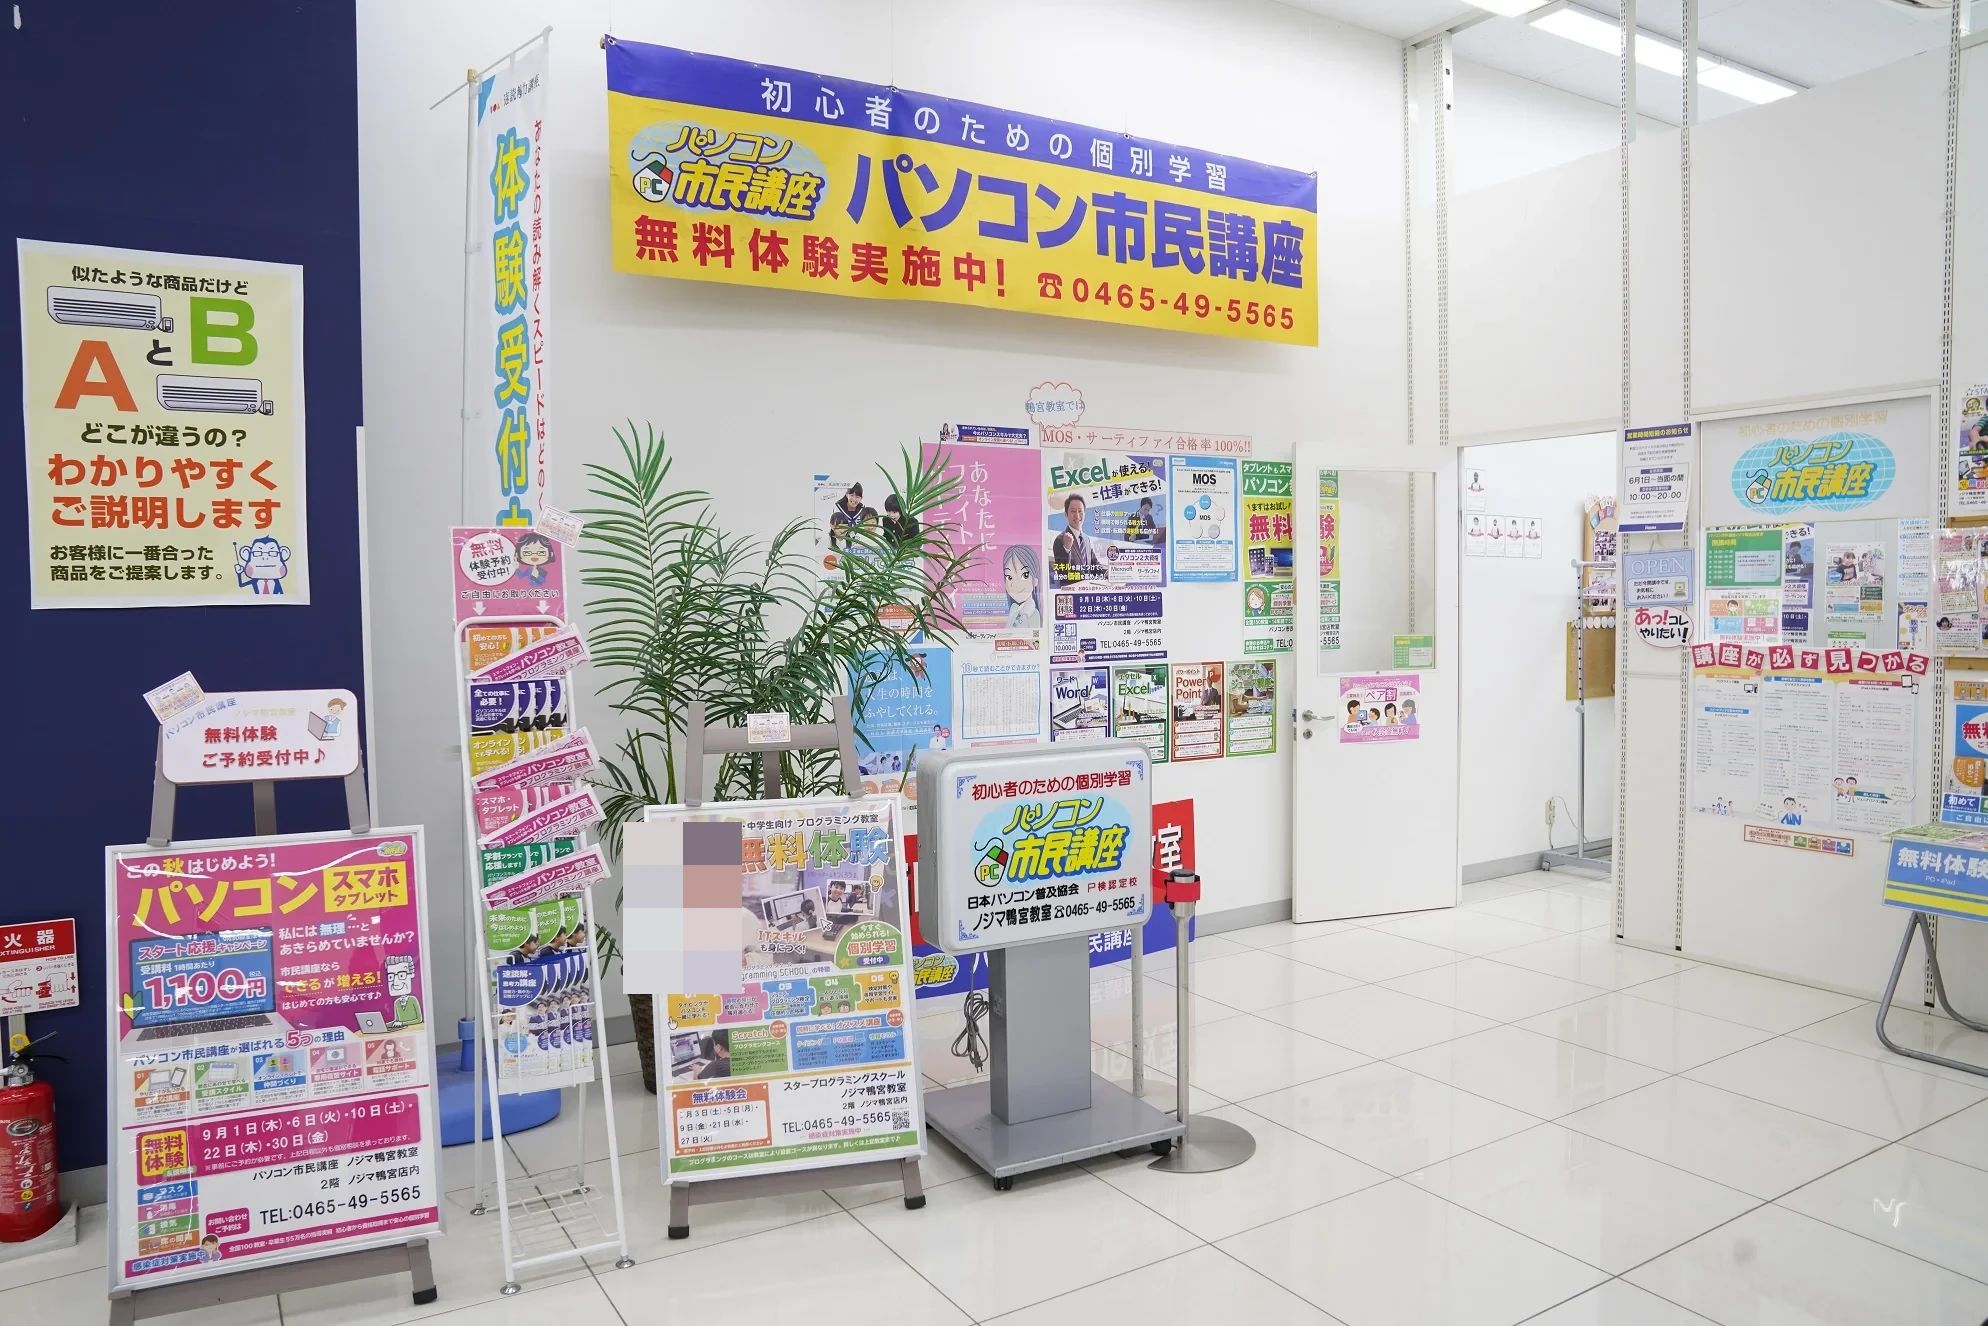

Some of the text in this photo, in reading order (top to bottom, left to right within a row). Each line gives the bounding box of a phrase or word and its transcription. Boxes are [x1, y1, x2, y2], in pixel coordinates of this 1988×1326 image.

[760, 77, 1229, 192] 初心者のための個別学習
[665, 125, 794, 165] パソコン
[639, 177, 664, 196] PC
[673, 157, 824, 220] 市民講座
[846, 152, 1304, 290] パソコン市民講座
[634, 214, 1006, 298] 無料体験実施中!
[71, 265, 249, 296] 似たような商品だけど
[1072, 276, 1295, 331] 0465-49-5565
[54, 295, 259, 413] A と B
[1025, 400, 1085, 413] 鴨宮教室では
[80, 422, 248, 448] どこが違うの?
[1767, 439, 1854, 468] パソコン
[47, 453, 279, 492] わかりやすく
[1193, 473, 1217, 485] MOS
[1770, 461, 1878, 503] 市民講座
[1749, 486, 1765, 499] PC
[51, 494, 282, 530] ご説明します
[969, 461, 998, 552] あなたに
[49, 544, 214, 562] お客様に一番合った
[50, 564, 223, 582] 商品をご提案します。
[469, 557, 512, 572] 体験予約
[1631, 557, 1688, 576] OPEN
[461, 589, 560, 600] ご自由にお取りください
[1639, 625, 1688, 643] やりたい!
[1694, 643, 1928, 673] 講座が必ず見つかる
[1118, 682, 1151, 696] Excel
[1176, 676, 1207, 688] Power
[1056, 685, 1089, 700] Word
[1176, 688, 1202, 699] Point
[1365, 687, 1397, 702] ペア割
[864, 704, 939, 719] ふやしてくれる。
[203, 725, 279, 745] 無料体験
[473, 738, 512, 749] オンライン
[527, 751, 588, 774] パソコン教室
[971, 769, 1132, 801] 初心者のための個別学習
[482, 804, 520, 815] タブレット
[1947, 794, 1976, 807] 初めて
[532, 797, 592, 830] パソコン教室
[797, 813, 880, 829] プログラミング教室
[1002, 796, 1104, 835] パソコン
[742, 827, 890, 874] 無料体験
[1006, 824, 1130, 883] 市民講座
[126, 851, 277, 880] この秋はじめよう!
[536, 855, 601, 884] パソコン教室
[1897, 845, 1988, 878] 無料体験
[329, 865, 400, 893] スマホ
[979, 863, 1000, 882] PC
[131, 873, 319, 927] パソコン
[333, 891, 399, 908] タブレット
[967, 883, 1080, 910] 日本パソコン普及協会
[972, 896, 1136, 931] ノジマ鴨宮教室 0465-49-5565
[758, 930, 806, 943] ITスキル
[850, 928, 890, 940] 始められる!
[860, 923, 881, 933] 今すぐ
[137, 938, 268, 961] スタート応援キャンペーン
[279, 928, 416, 957] あきらめていませんか?
[760, 943, 807, 954] も身につく!
[846, 939, 897, 956] 個別学習
[140, 963, 172, 976] 受講料
[279, 961, 341, 978] 市民講座なら
[862, 955, 885, 965] 受付中
[779, 967, 809, 977] SCHOOL
[732, 1029, 769, 1041] Scratch
[783, 1071, 906, 1092] スタープログラミングスクール
[841, 1083, 907, 1099] ノジマ鴨宮教室
[692, 1088, 749, 1105] 無料体験会
[842, 1096, 909, 1111] 2階 ノジマ鴨宮店内
[782, 1110, 892, 1134] TEL:0465-49-5565
[144, 1134, 184, 1155] 無料
[145, 1152, 184, 1173] 体験
[252, 1160, 340, 1181] パソコン市民講座
[346, 1147, 419, 1168] ノジマ鴨宮教室
[320, 1165, 421, 1190] 2階 ノジマ鴨宮店内
[259, 1185, 422, 1226] TEL:0465-49-5565
[207, 1213, 249, 1227] お問い合わせ
[214, 1222, 243, 1234] ご予約は
